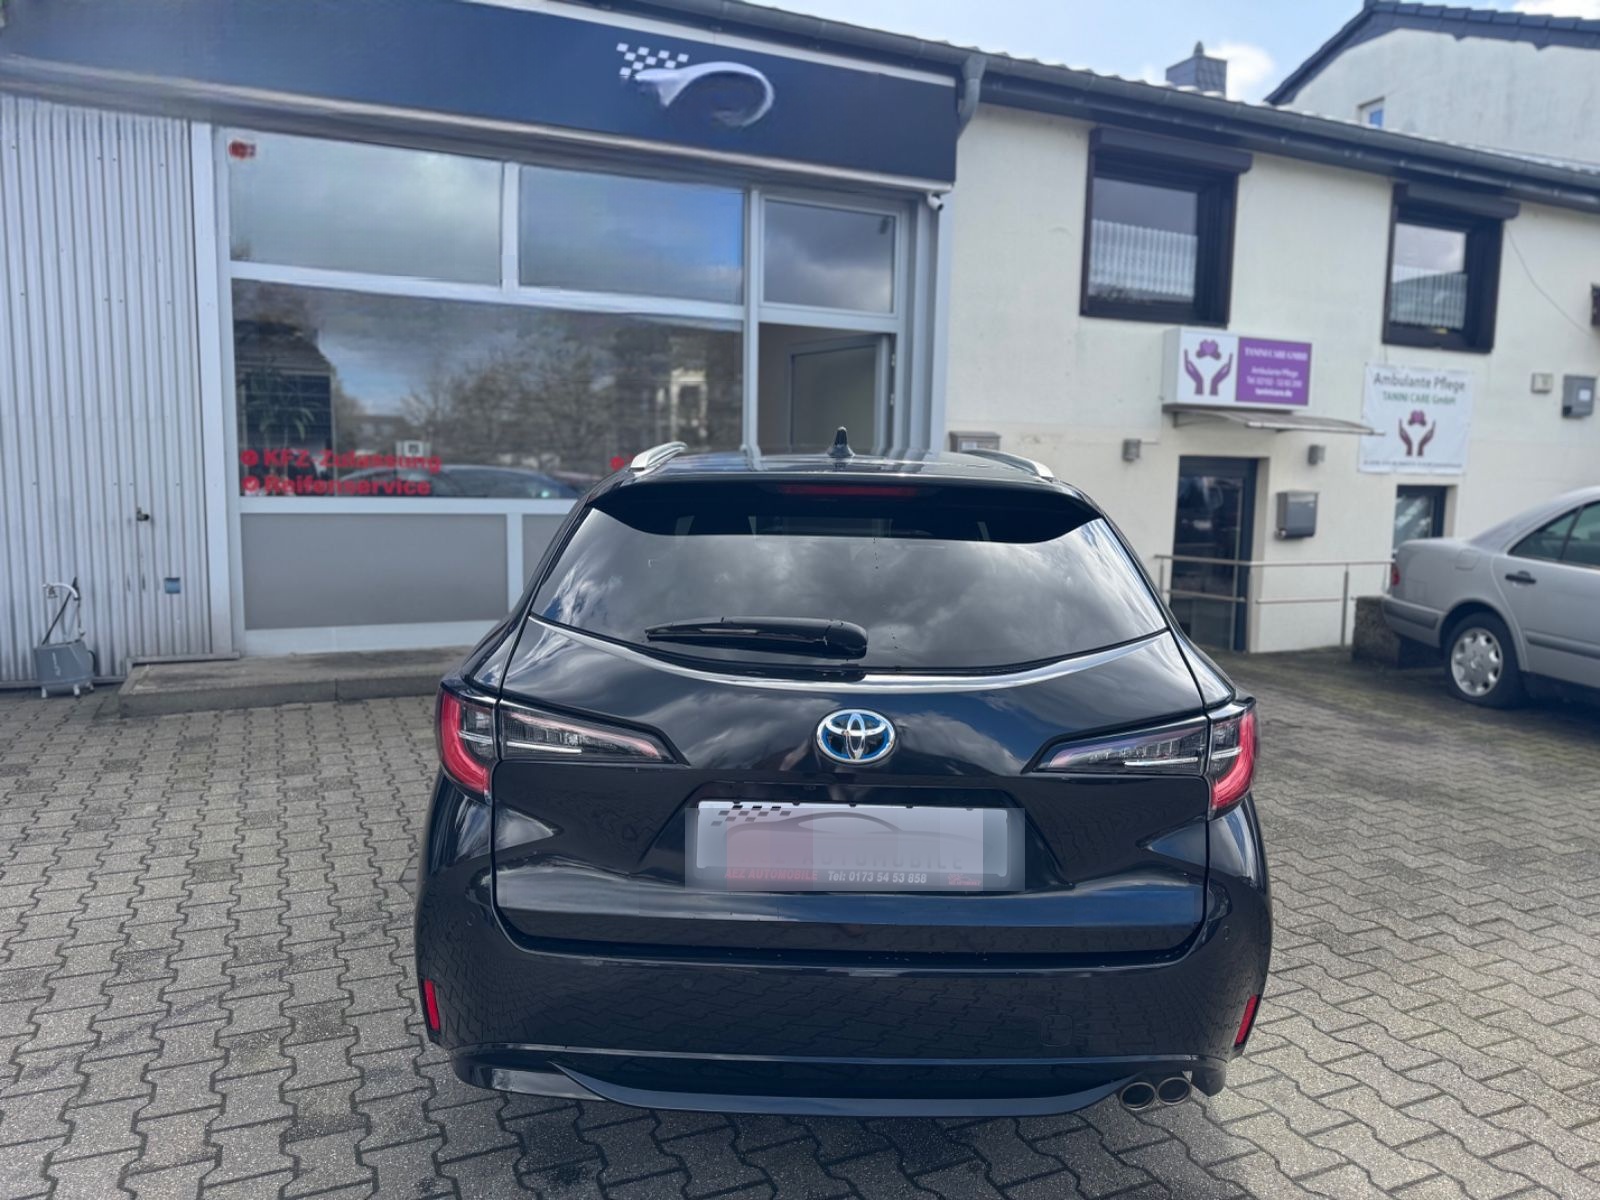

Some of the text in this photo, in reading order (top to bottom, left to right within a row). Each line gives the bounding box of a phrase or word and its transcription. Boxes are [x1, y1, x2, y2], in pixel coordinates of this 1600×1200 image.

[1373, 373, 1466, 395] Ambulante Pflege
[263, 448, 441, 473] KFZ-Zulassung
[264, 474, 432, 496] Reifenservice
[725, 868, 927, 884] AEZ AUTOMOBILE Tel: 0173 54 53 858
